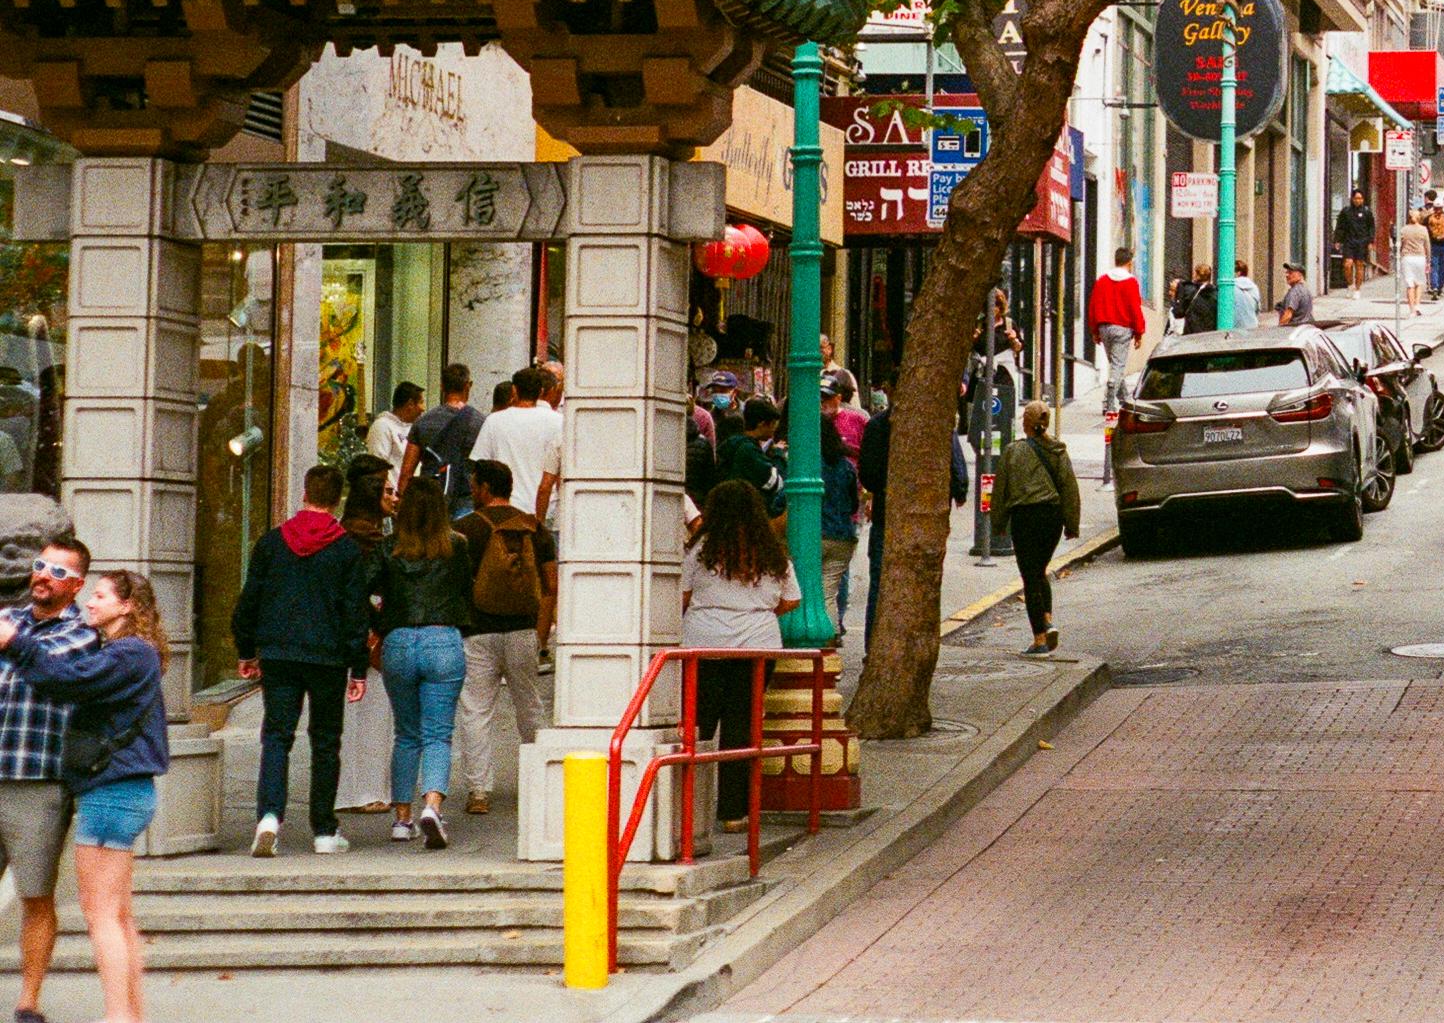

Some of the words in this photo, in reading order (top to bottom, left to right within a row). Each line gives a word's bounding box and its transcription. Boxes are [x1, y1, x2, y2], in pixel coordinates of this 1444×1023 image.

[390, 53, 466, 124] MICHAEL
[845, 160, 901, 177] GRILL
[933, 174, 952, 184] Pay
